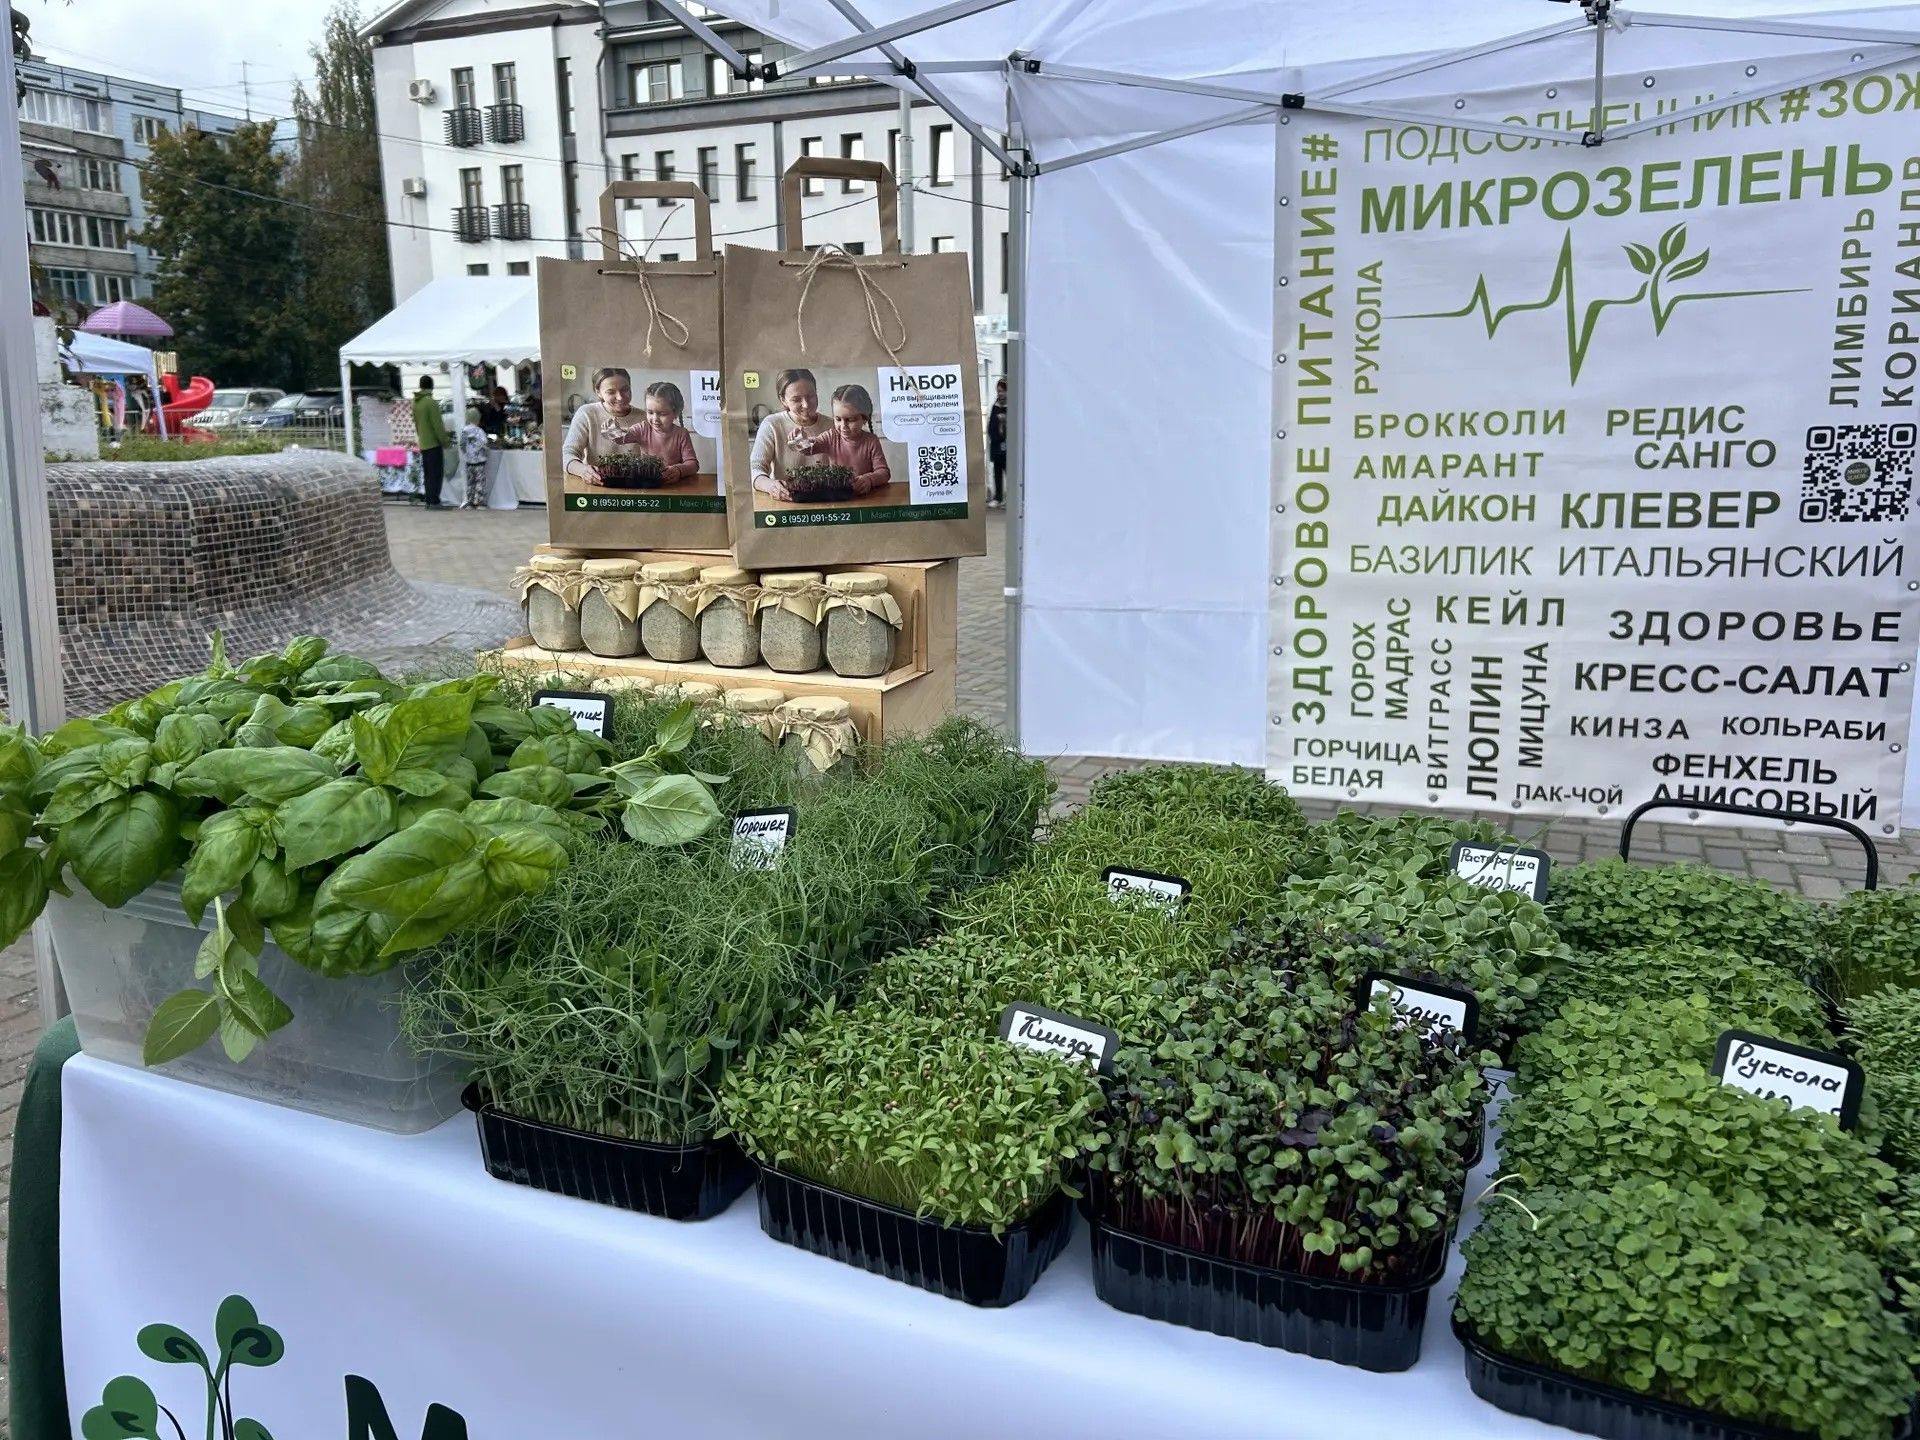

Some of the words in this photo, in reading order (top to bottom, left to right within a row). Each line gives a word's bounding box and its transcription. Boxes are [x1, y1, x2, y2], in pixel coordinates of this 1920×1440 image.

[1360, 144, 1893, 234] МИКРОЗЕЛЕНЬ
[1829, 208, 1875, 408] ЛИМБИРЬ
[1354, 260, 1383, 394] РУКОЛА
[564, 368, 574, 376] 5+
[746, 376, 757, 385] 5+
[890, 374, 957, 391] НАБОР
[909, 402, 959, 410] микрозелени
[1354, 409, 1566, 439] БРОККОЛИ
[1606, 405, 1746, 440] РЕДИС
[1353, 452, 1544, 479] АМАРАНТ
[1634, 439, 1777, 470] САНГО
[600, 499, 620, 508] (952)
[621, 500, 660, 508] 091-55-22
[789, 514, 809, 525] (952)
[811, 512, 851, 523] 091-55-22
[1377, 488, 1536, 527] ДАЙКОН
[1561, 491, 1781, 529] КЛЕВЕР
[1350, 545, 1534, 576] БАЗИЛИК
[1558, 538, 1904, 578] ИТАЛЬЯНСКИЙ
[1292, 447, 1333, 725] ЗДОРОВОЕ
[1436, 590, 1565, 627] КЕЙЛ
[1608, 610, 1902, 646] ЗДОРОВЬЕ
[1351, 622, 1376, 717] ГОРОХ
[1384, 598, 1414, 720] МАДРАС
[1574, 662, 1900, 698] КРЕСС-САЛАТ
[1426, 638, 1452, 789] ВИТГРАСС
[1518, 642, 1550, 768] МИЦУНА
[1466, 656, 1503, 801] ЛЮПИН
[1570, 716, 1690, 740] КИНЗА
[1721, 716, 1886, 741] КОЛЬРАБИ
[1293, 738, 1422, 765] ГОРЧИЦА
[1652, 753, 1838, 785] ФЕНХЕЛЬ
[1292, 766, 1383, 789] БЕЛАЯ
[1515, 783, 1623, 805] ПАК-ЧОЙ
[1019, 1016, 1092, 1058] Кинза
[1732, 1042, 1841, 1092] Руккола
